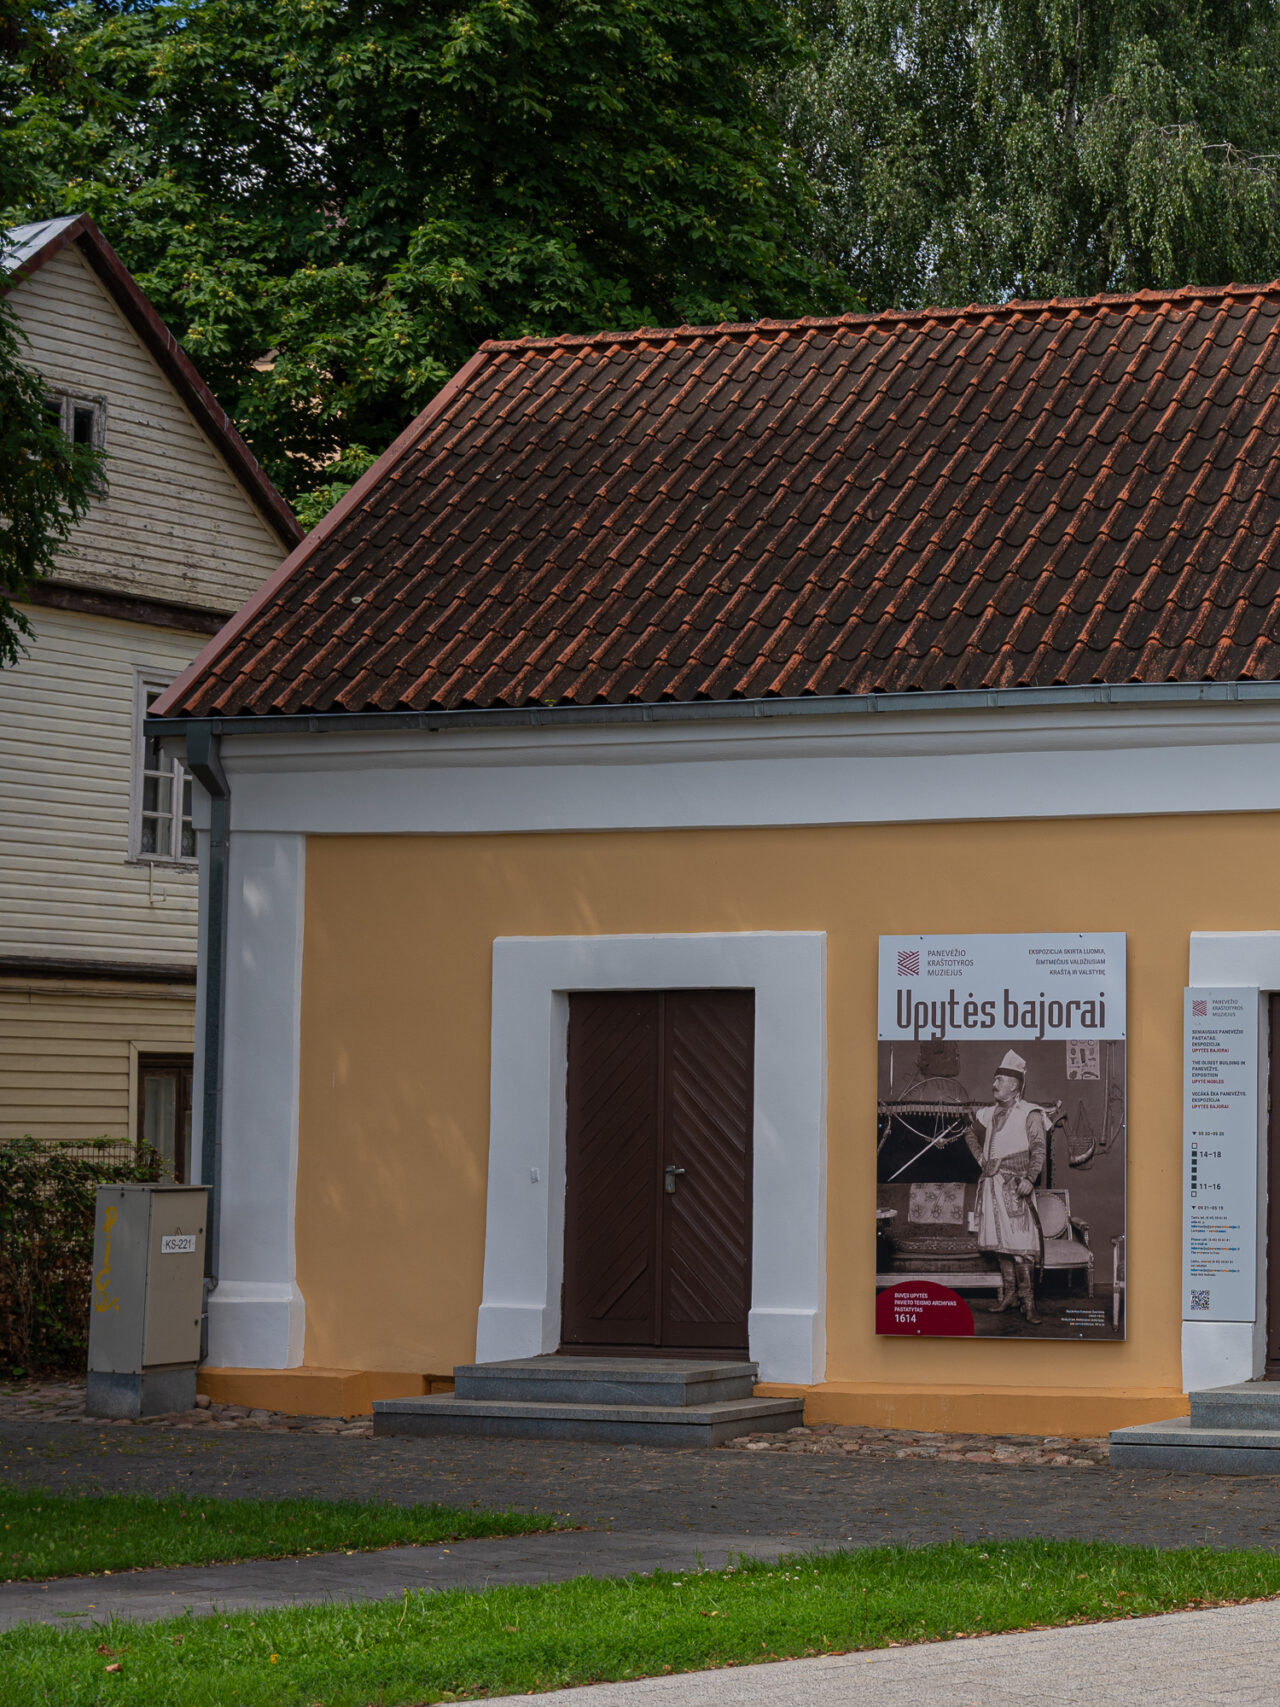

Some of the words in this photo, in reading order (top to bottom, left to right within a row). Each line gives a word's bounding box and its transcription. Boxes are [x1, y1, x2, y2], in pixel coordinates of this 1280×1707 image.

[927, 948, 966, 957] PANEVĖŽIO
[927, 959, 974, 967] KRAŠTOTYROS
[927, 969, 963, 977] MUZIEJUS
[896, 988, 996, 1041] Upytės
[1003, 988, 1105, 1041] bajorai
[165, 1238, 192, 1250] KS-221
[895, 1314, 917, 1323] 1614
